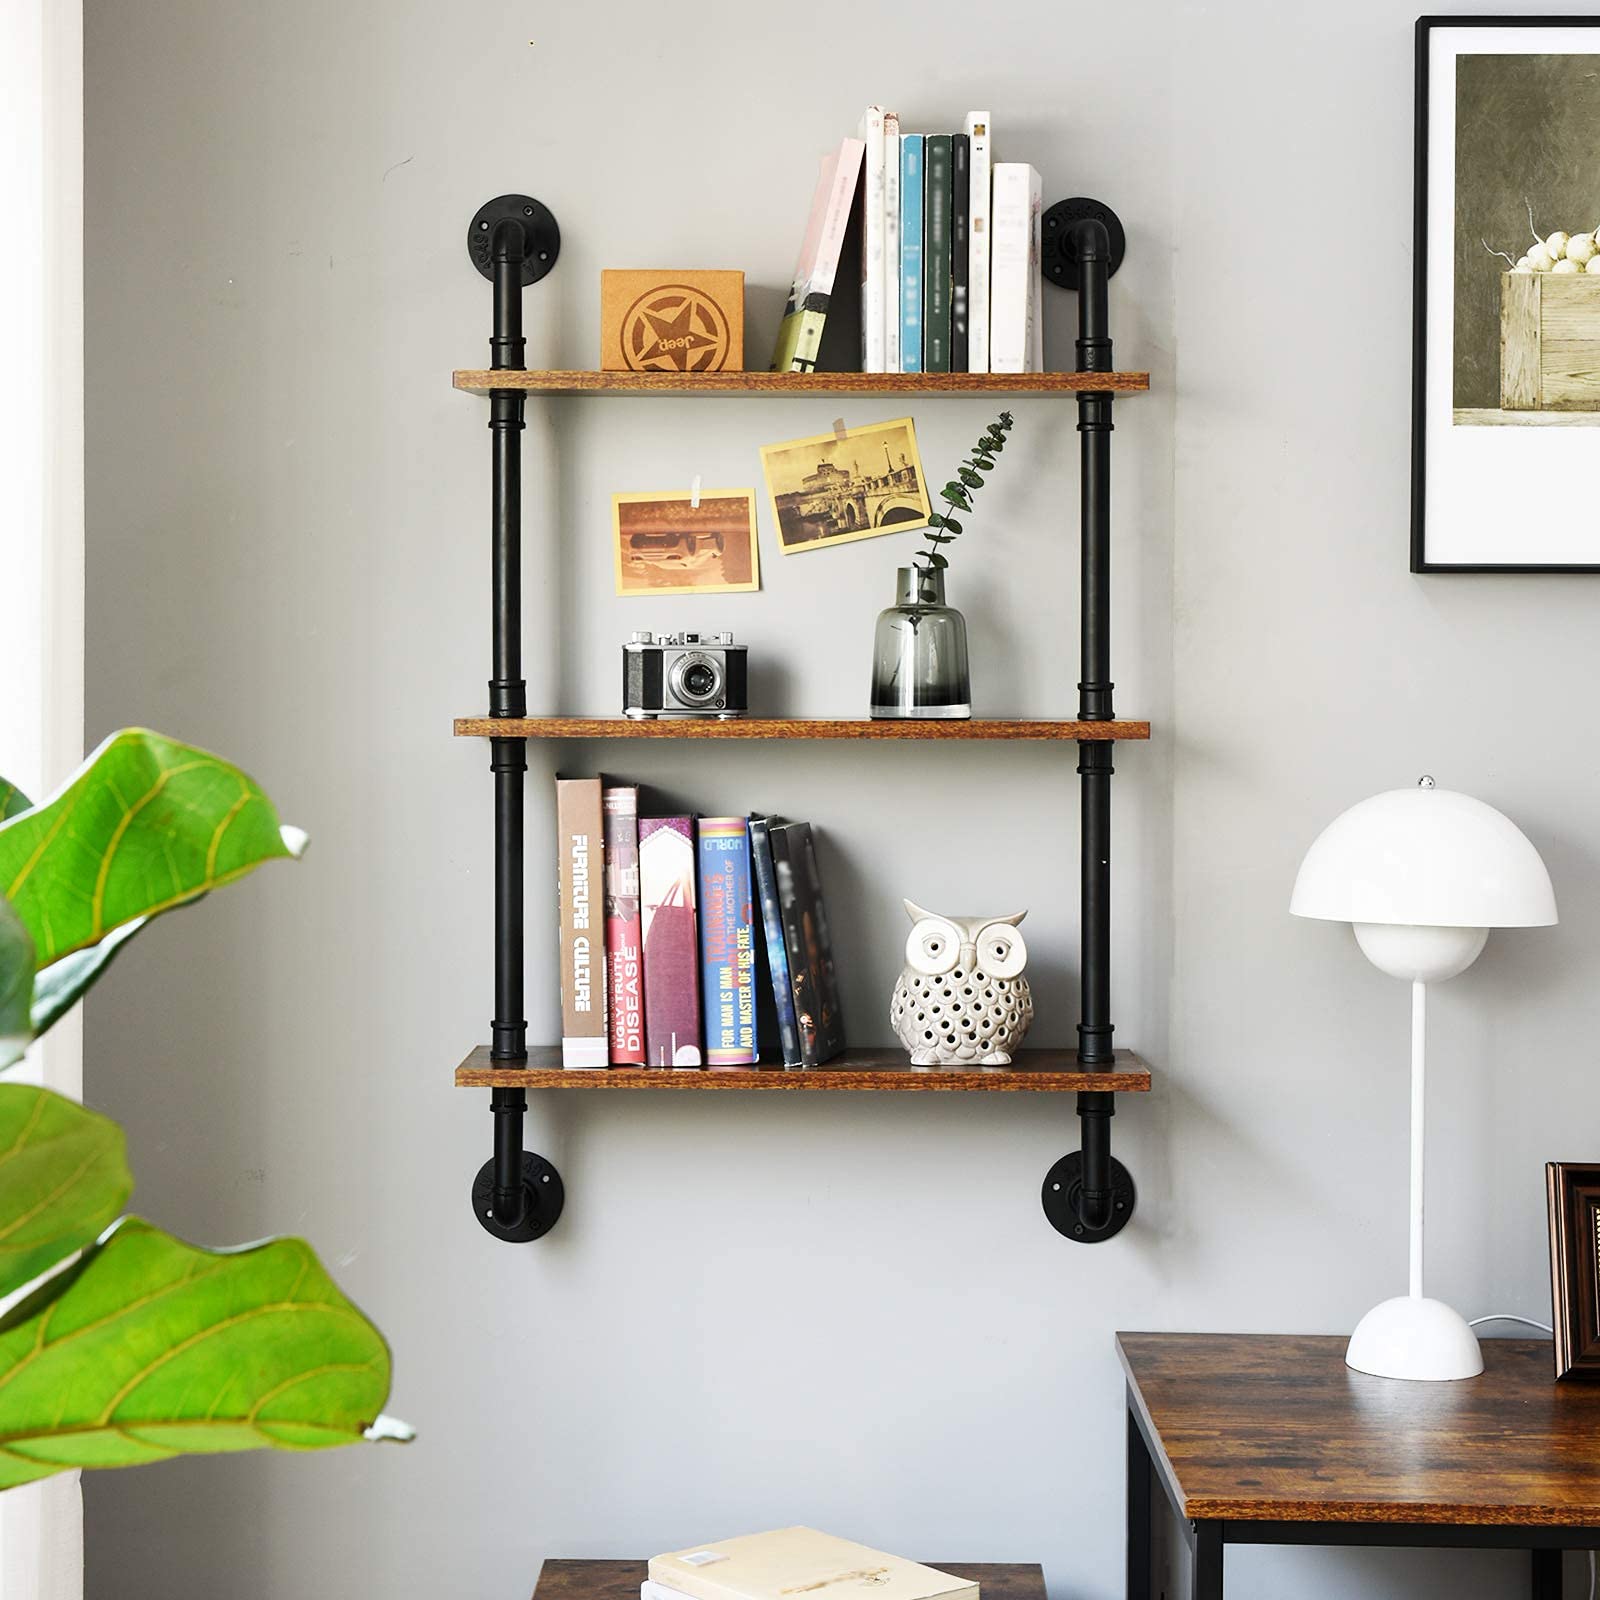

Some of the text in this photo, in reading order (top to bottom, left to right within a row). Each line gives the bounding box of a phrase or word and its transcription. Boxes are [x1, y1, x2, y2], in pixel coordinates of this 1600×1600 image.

[658, 335, 694, 351] Jeep
[725, 874, 736, 914] MOTHER
[726, 916, 736, 935] THE
[736, 924, 750, 950] FATE.
[572, 936, 591, 1012] CULTURE
[737, 951, 751, 969] HIS
[738, 970, 751, 984] OF
[613, 951, 626, 1049] UGLY TRUTH
[624, 945, 641, 1051] DISEASE
[720, 967, 735, 1048] FOR MAN IS MAN
[738, 986, 753, 1024] MASTER
[740, 1027, 753, 1048] AND
